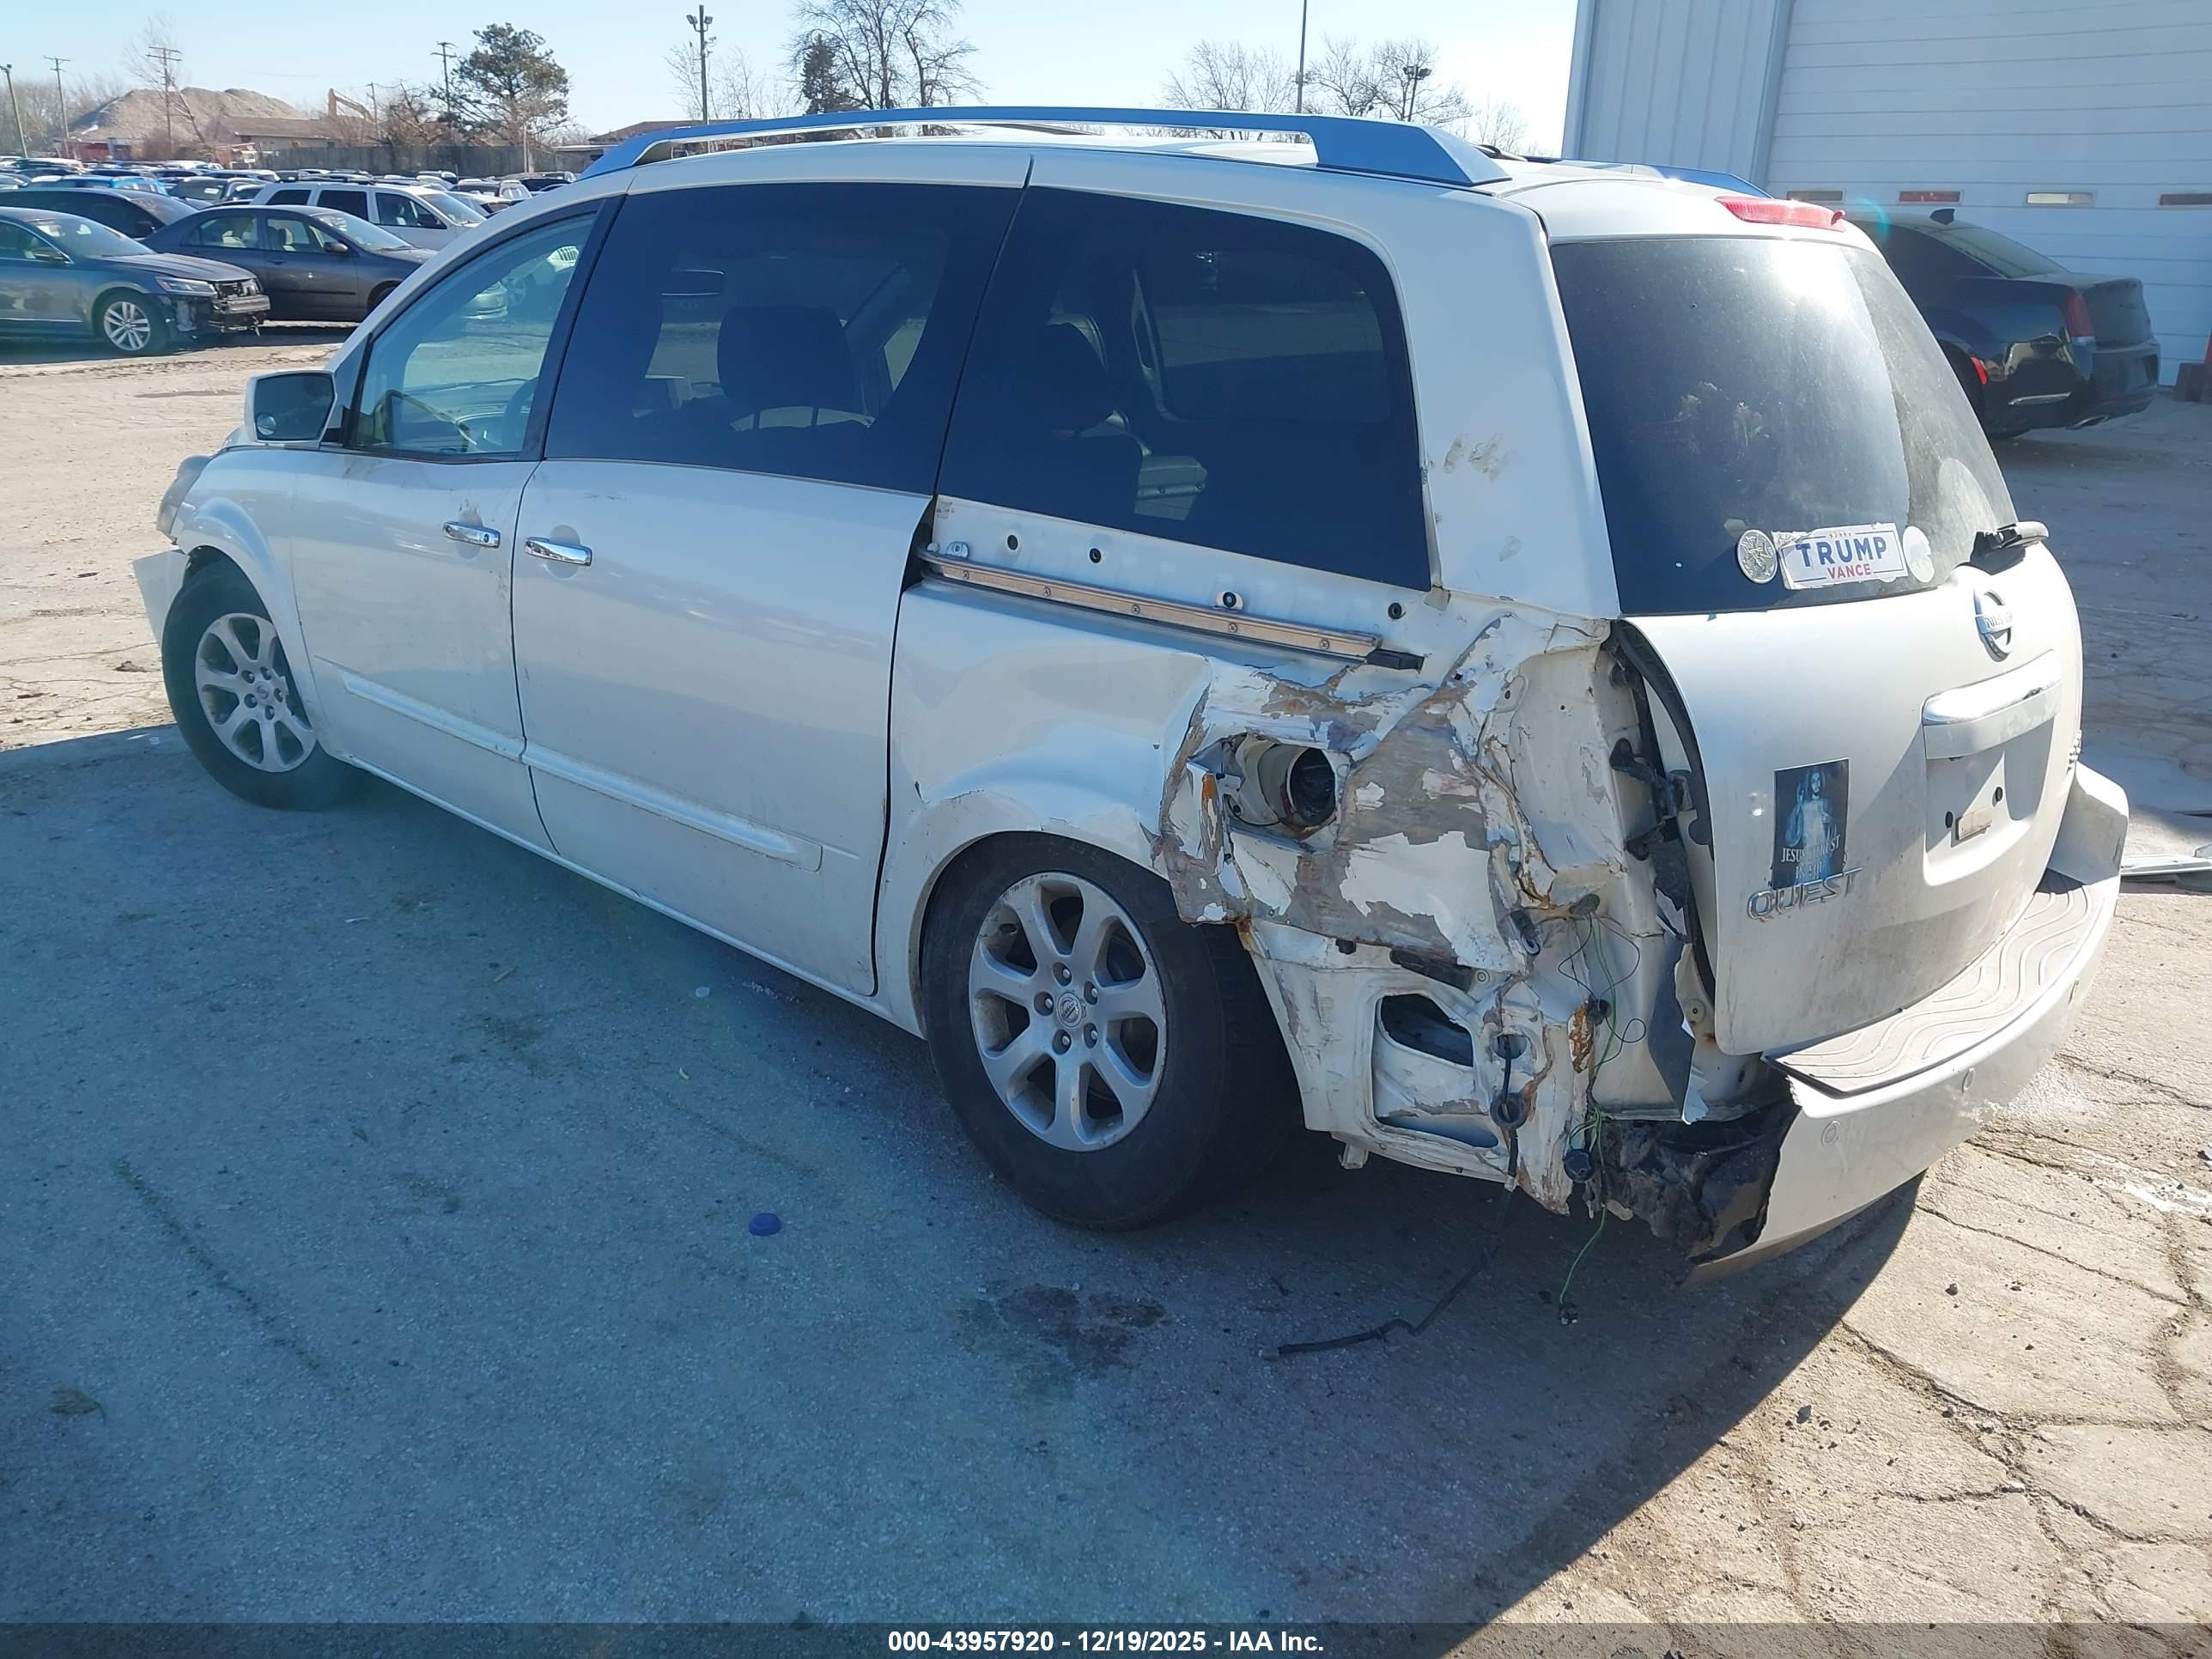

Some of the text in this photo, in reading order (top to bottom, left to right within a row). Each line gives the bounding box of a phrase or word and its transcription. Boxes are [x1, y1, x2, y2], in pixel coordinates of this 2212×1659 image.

[1796, 537, 1887, 568] TRUMP
[1826, 563, 1872, 580] VANCE
[1781, 847, 1806, 863] JESUS
[1747, 866, 1862, 922] QUEST
